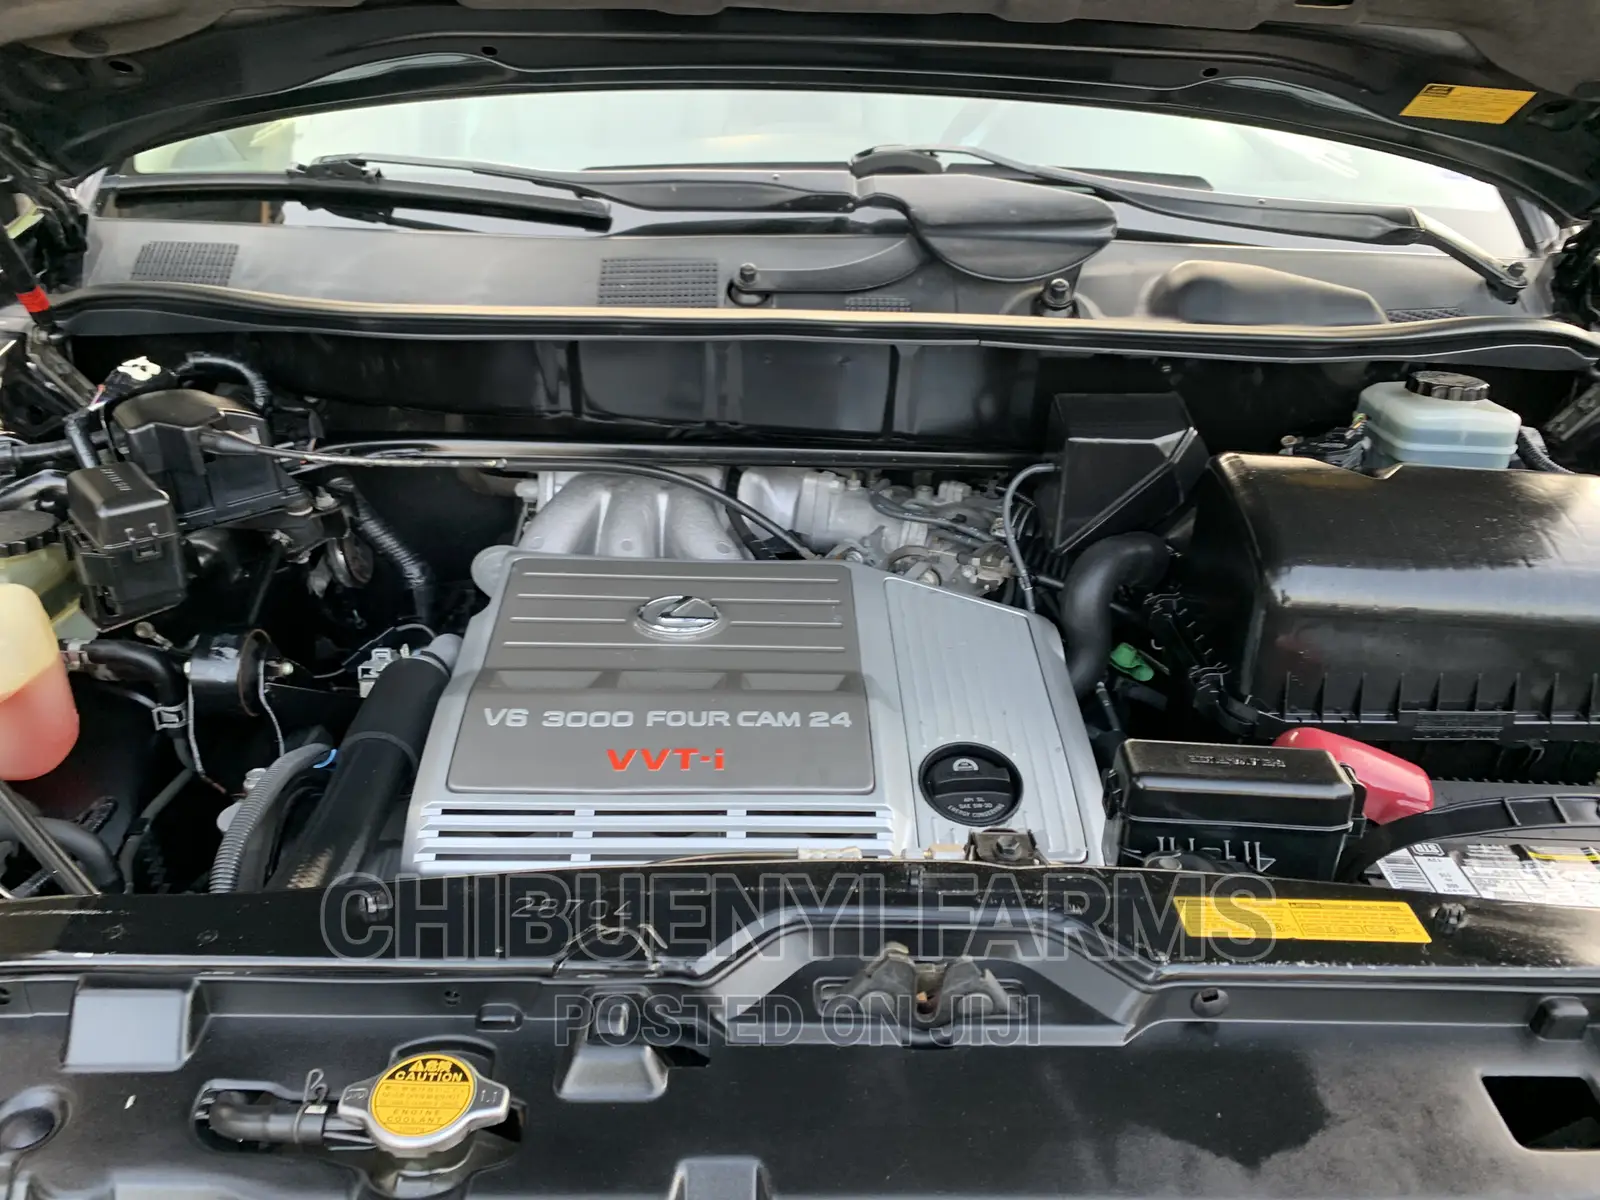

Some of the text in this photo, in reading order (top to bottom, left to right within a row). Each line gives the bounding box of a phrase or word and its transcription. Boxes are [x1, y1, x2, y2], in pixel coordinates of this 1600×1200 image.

[484, 708, 852, 728] V6 3000 FOUR CAM 24
[606, 748, 725, 772] VVT-i
[394, 1069, 463, 1082] CAUTION
[393, 1109, 441, 1117] ENGINE
[386, 1116, 443, 1124] COOLANT
